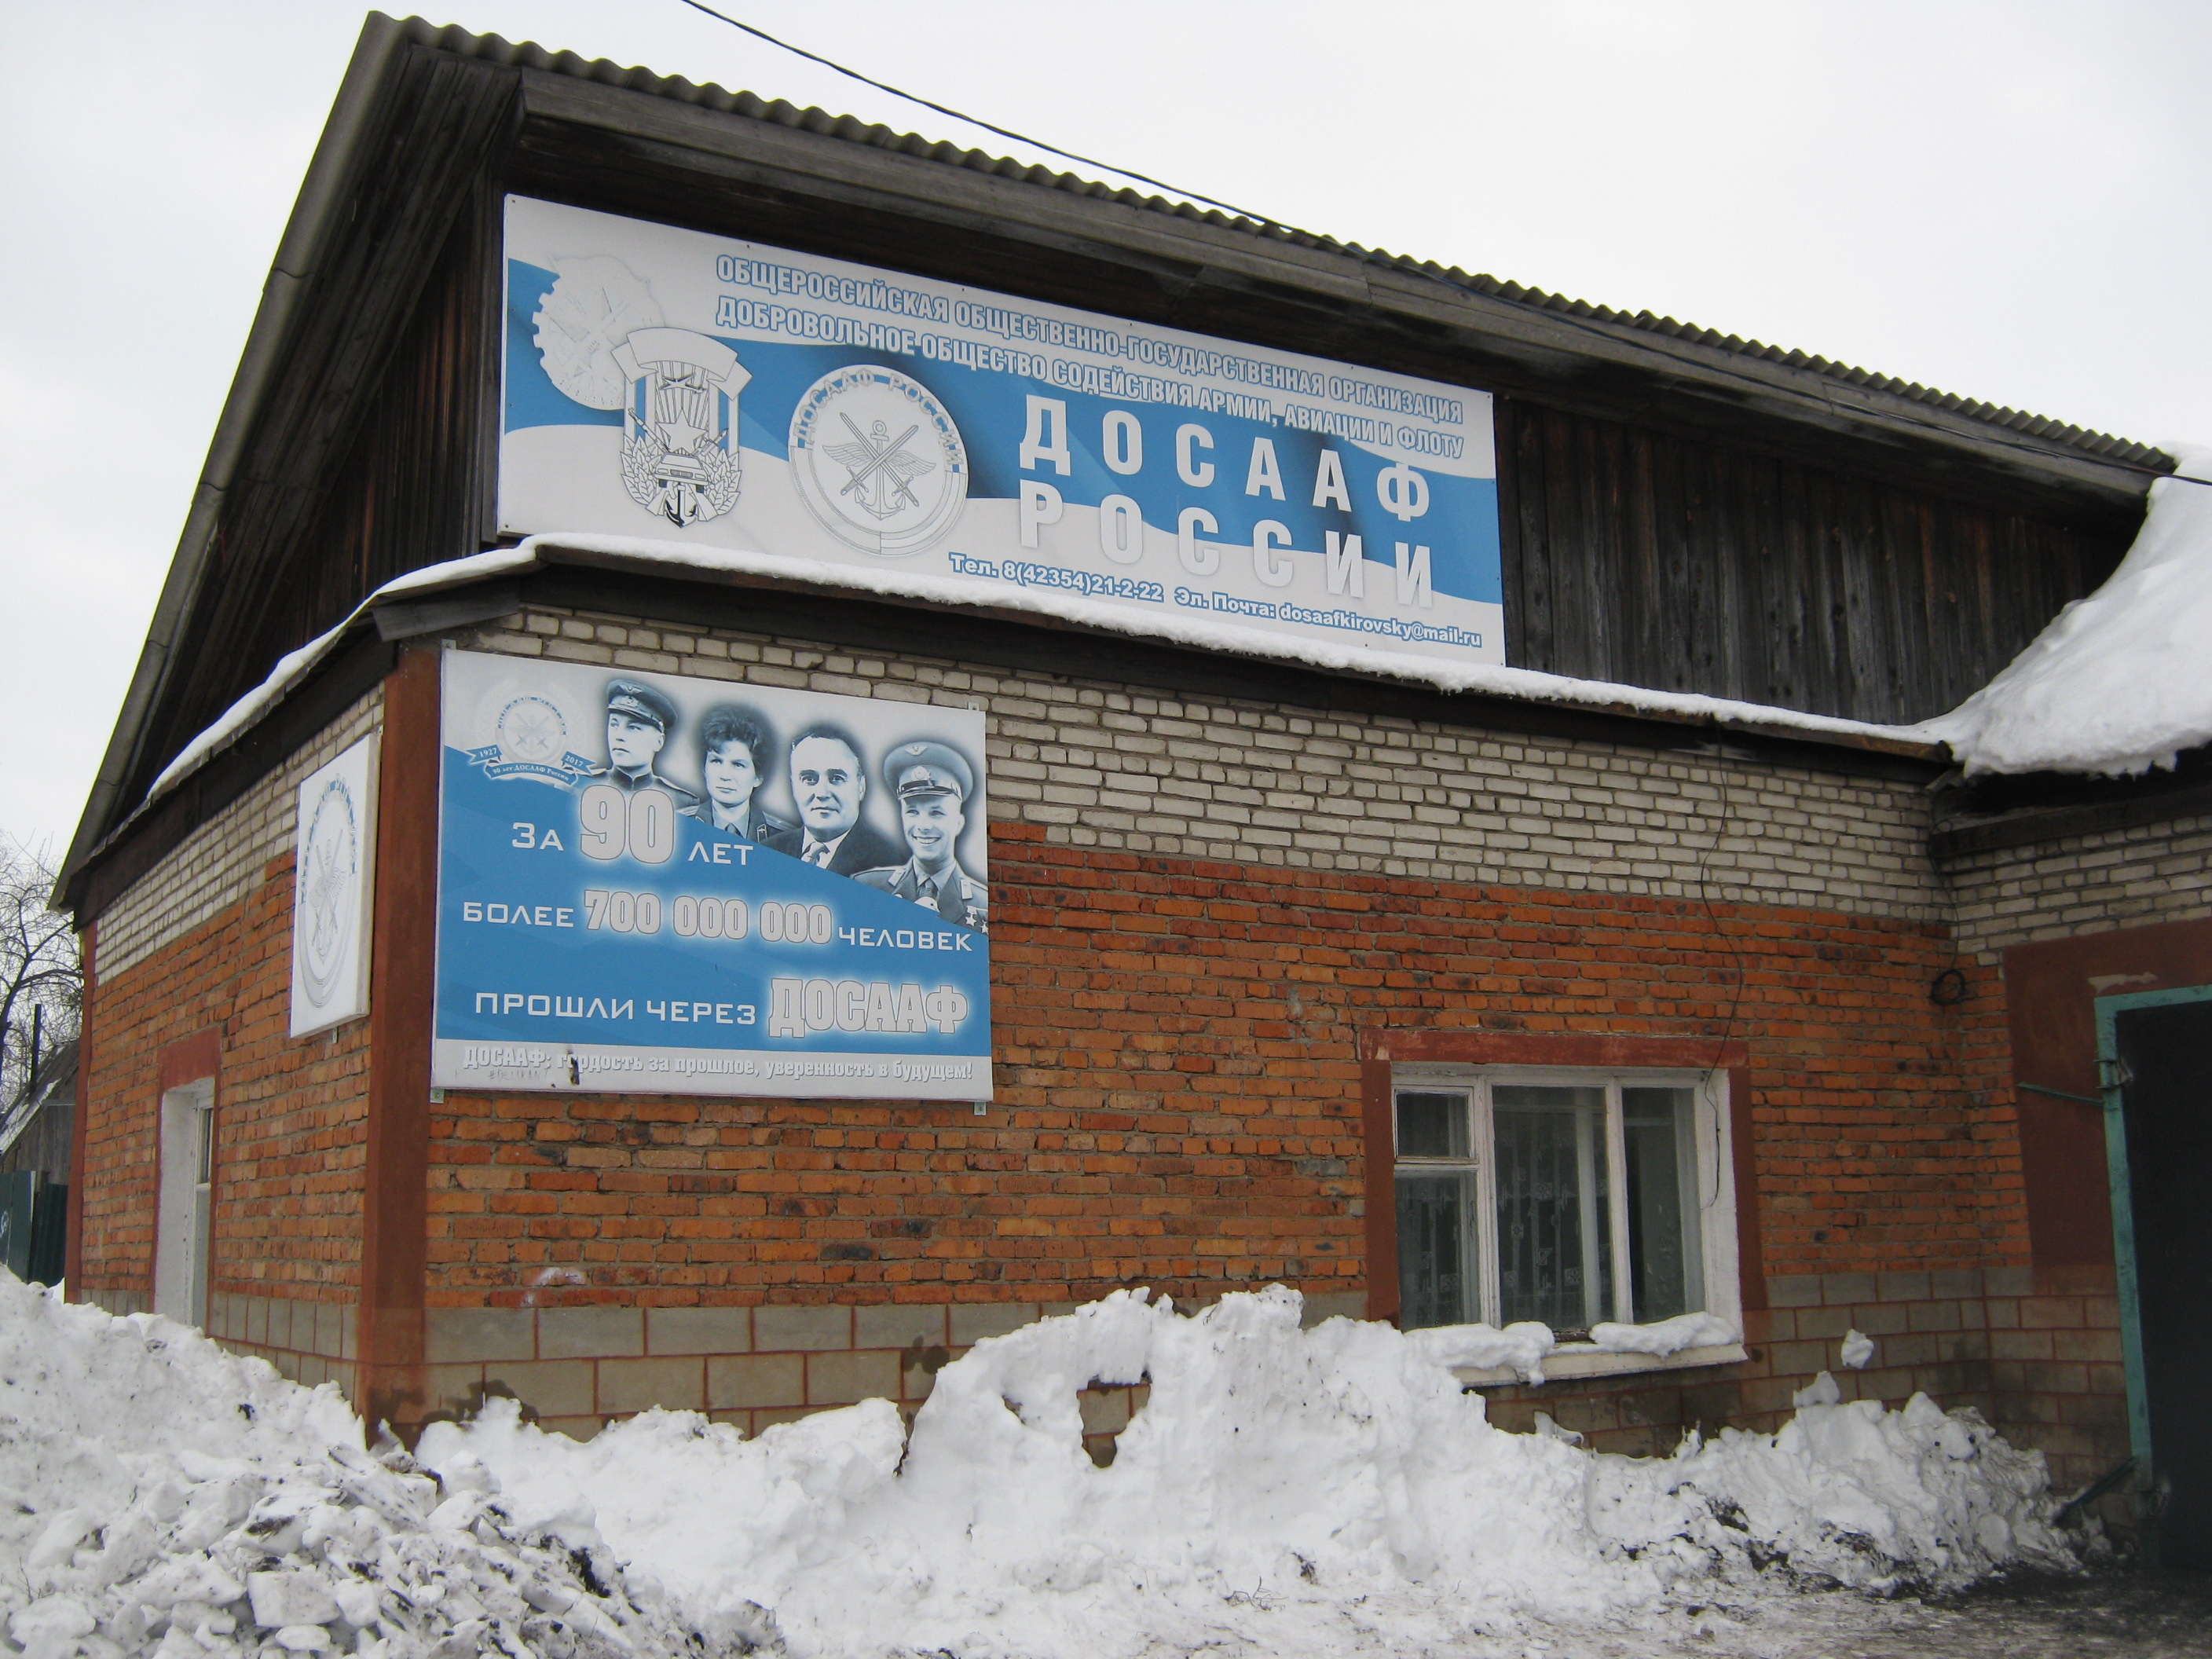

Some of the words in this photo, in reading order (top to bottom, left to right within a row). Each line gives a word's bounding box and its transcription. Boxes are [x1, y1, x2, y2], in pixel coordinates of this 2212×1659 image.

[716, 255, 949, 323] ОБЩЕРОССИЙСКАЯ
[954, 301, 1324, 397] ОБЩЕСТВЕННО-ГОСУДАРСТВЕННАЯ
[1329, 376, 1463, 424] ОРГАНИЗАЦИЯ
[716, 295, 916, 356] ДОБРОВОЛЬНОЕ
[921, 333, 1046, 380] ОБЩЕСТВО
[1053, 358, 1193, 408] СОДЕЙСТВИЯ
[1199, 387, 1278, 427] АРМИИ,
[1284, 404, 1375, 443] АВИАЦИИ
[1379, 422, 1393, 446] И
[1397, 427, 1464, 459] ФЛОТУ
[793, 368, 875, 445] ДОСААФ
[888, 372, 965, 466] РОССИИ
[1020, 394, 1430, 522] ДОСААФ
[1019, 479, 1433, 608] РОССИИ
[949, 551, 999, 579] Тел.
[1002, 559, 1164, 603] 8(42354)21-2-22
[1174, 587, 1210, 610] Эл.
[1212, 591, 1276, 619] Почта:
[1280, 602, 1482, 649] dosaafkirovsky@mail.ru
[479, 747, 497, 758] 1927
[564, 754, 584, 767] 2017
[511, 822, 565, 851] ЗА
[580, 784, 676, 865] 90
[687, 841, 754, 866] ЛЕТ
[463, 901, 575, 928] БОЛЕЕ
[584, 889, 661, 935] 700
[673, 895, 749, 940] 000
[760, 902, 833, 944] 000
[838, 927, 973, 952] ЧЕЛОВЕК
[475, 992, 635, 1020] ПРОШЛИ
[646, 1000, 756, 1025] ЧЕРЕЗ
[768, 978, 969, 1038] ДОСААФ
[649, 1058, 670, 1072] за
[675, 1057, 760, 1079] прошлое,
[765, 1060, 875, 1080] уверенность
[878, 1063, 888, 1079] в
[892, 1060, 973, 1083] будущем!
